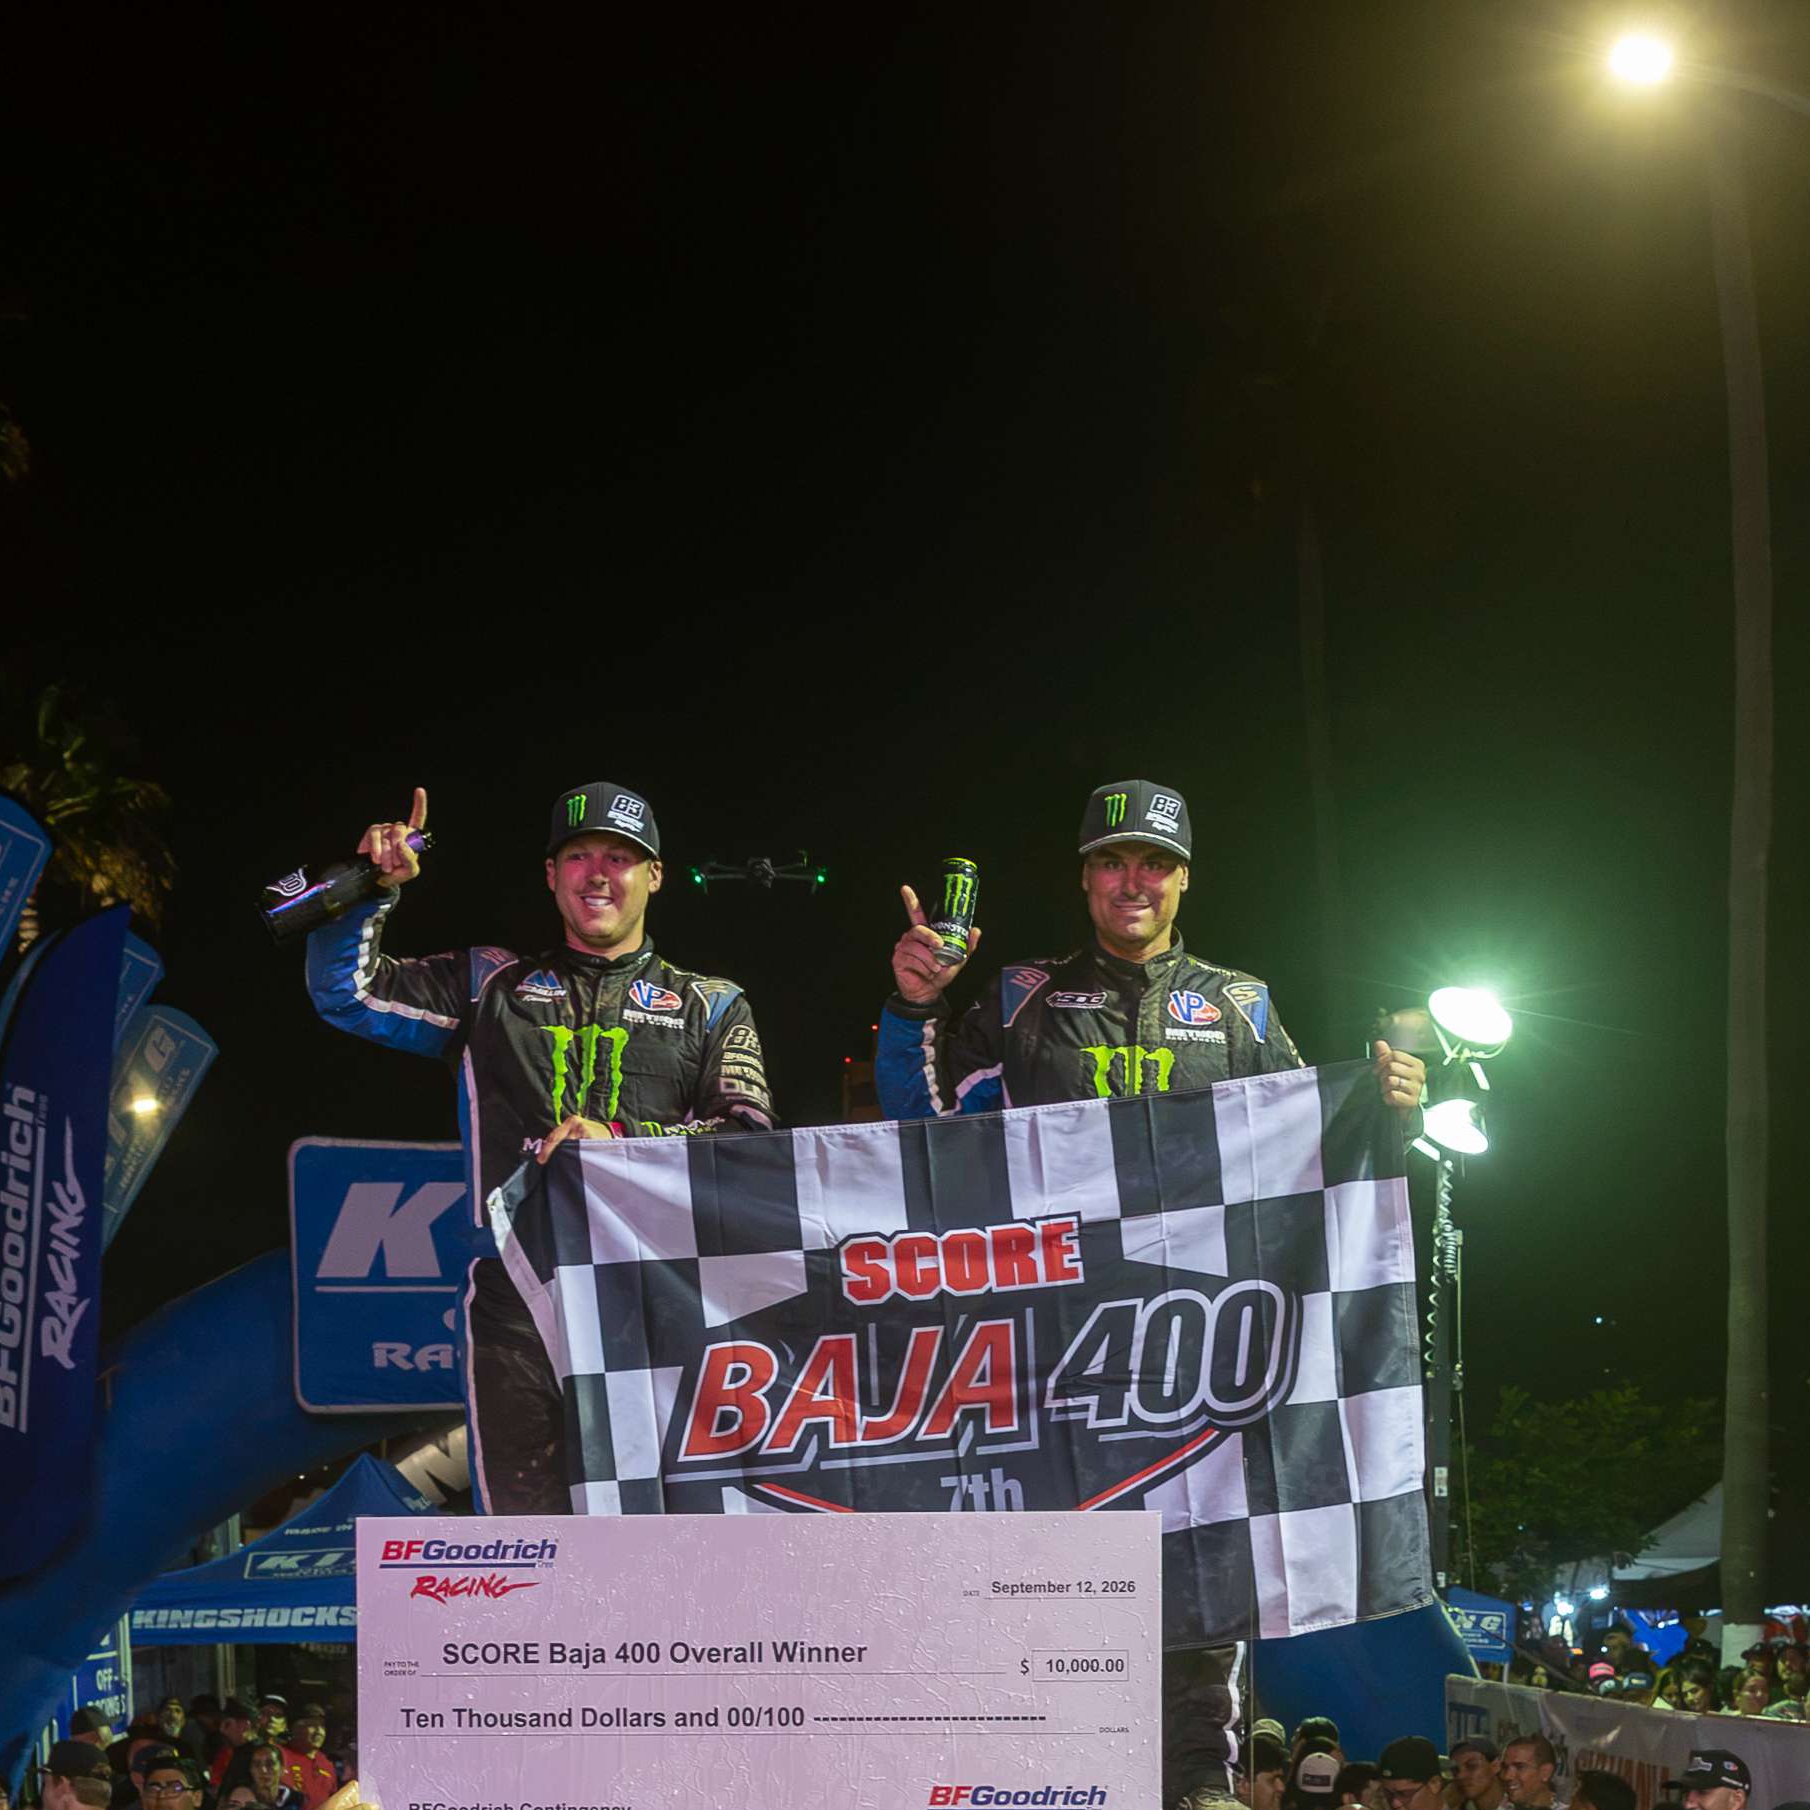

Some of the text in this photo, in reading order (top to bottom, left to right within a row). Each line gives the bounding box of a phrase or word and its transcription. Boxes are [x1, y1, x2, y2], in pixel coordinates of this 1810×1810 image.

[41, 1114, 90, 1371] RACING
[840, 1211, 1086, 1306] SCORE
[676, 1279, 1289, 1462] BAJA 400
[380, 1538, 558, 1561] BFGoodrich
[410, 1573, 541, 1604] RACING
[991, 1580, 1136, 1596] September 12, 2026
[132, 1605, 357, 1630] KINGSHOCKS
[442, 1641, 868, 1669] SCORE Baja 400 Overall Winner
[1019, 1657, 1125, 1676] $ 10,000.00
[400, 1705, 805, 1729] Ten Thousand Dollars and 00/100
[928, 1785, 1107, 1807] BFGoodrich
